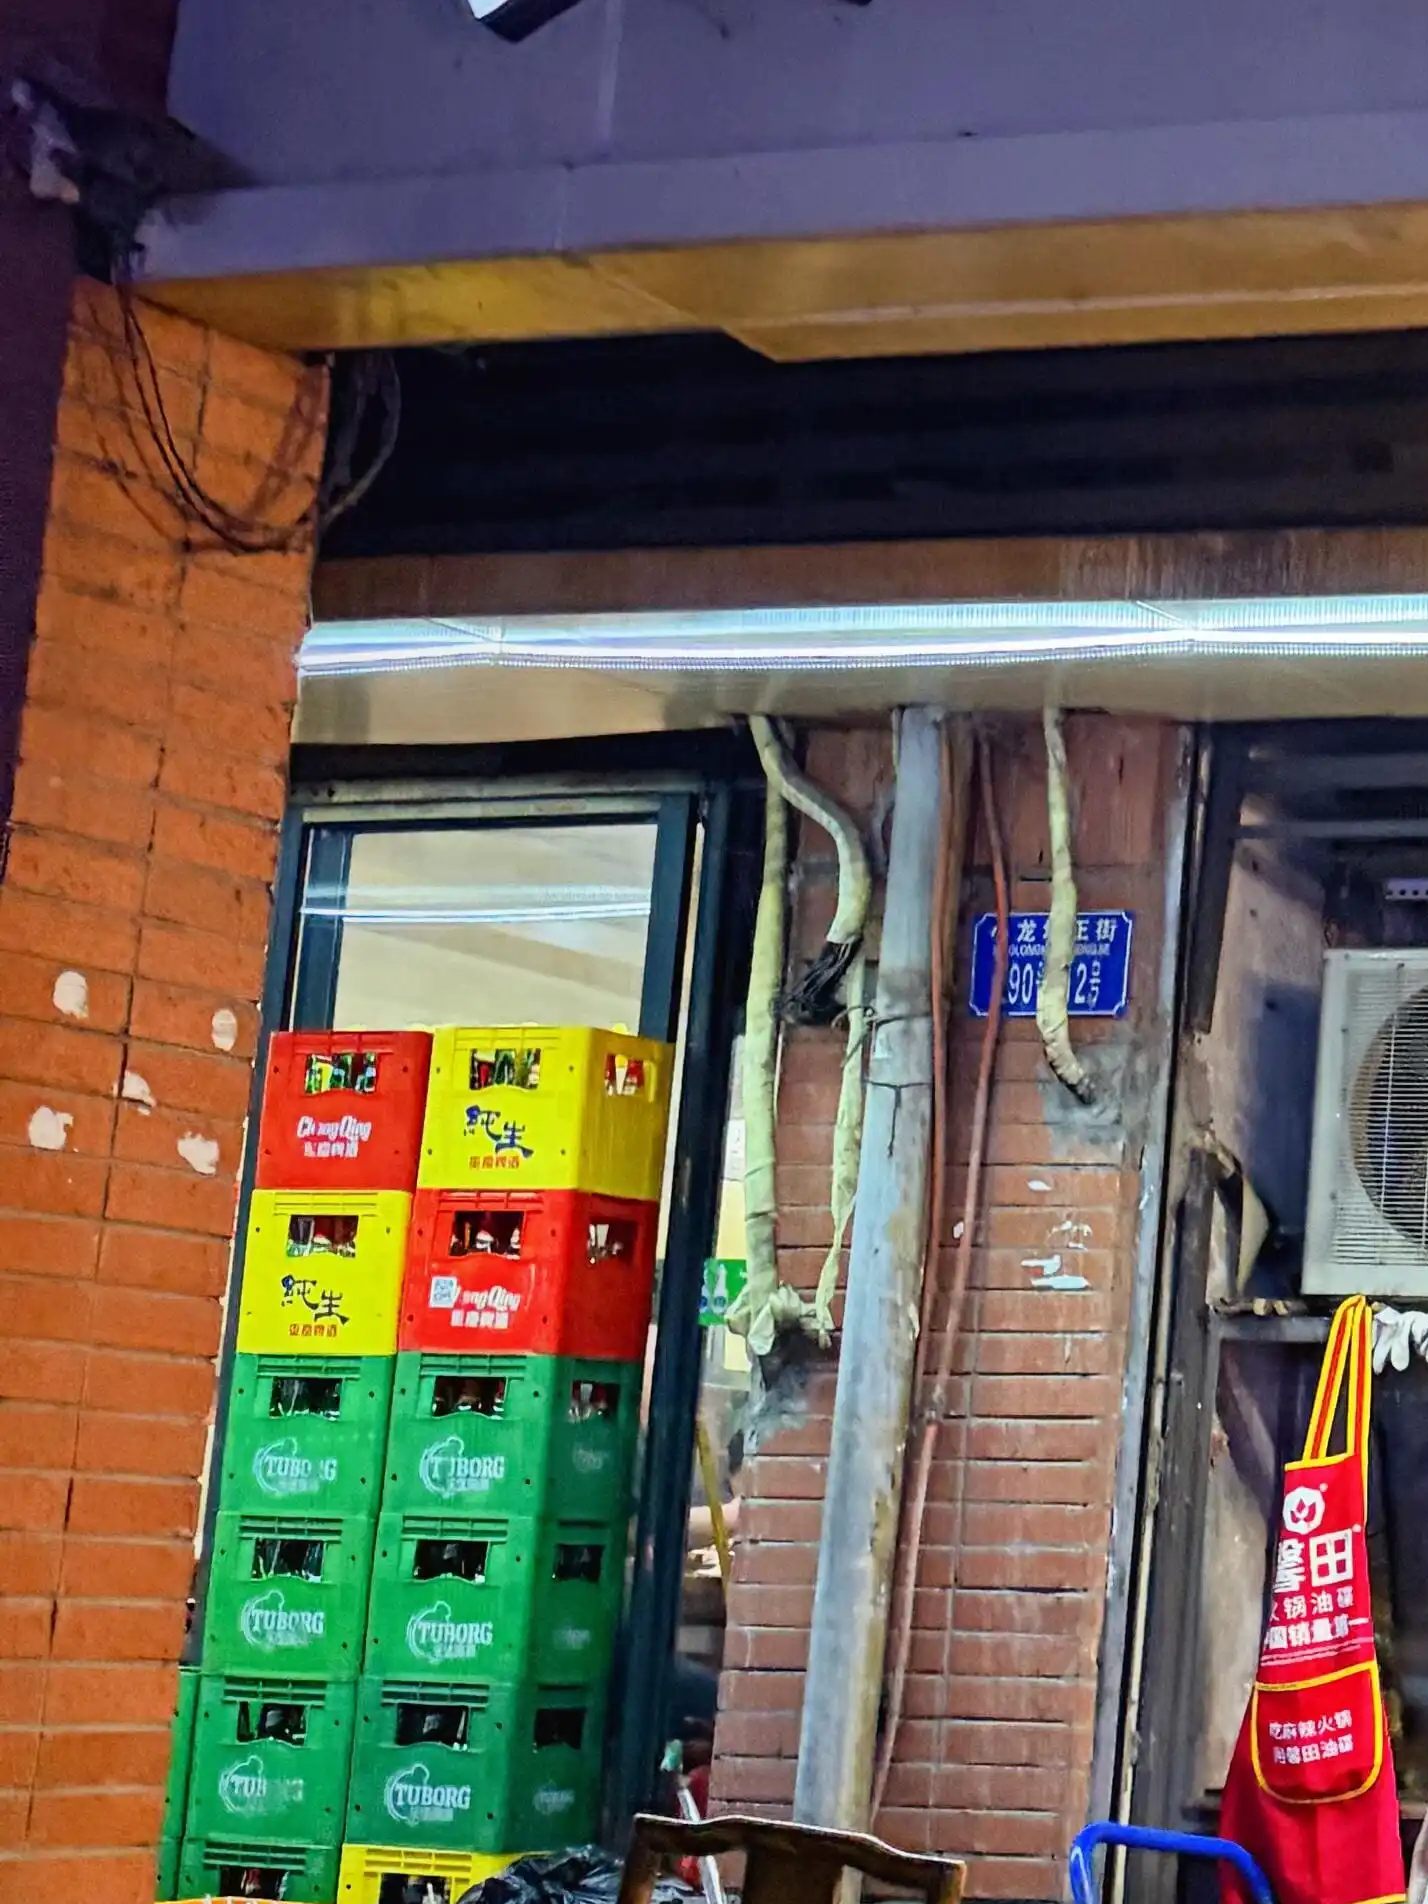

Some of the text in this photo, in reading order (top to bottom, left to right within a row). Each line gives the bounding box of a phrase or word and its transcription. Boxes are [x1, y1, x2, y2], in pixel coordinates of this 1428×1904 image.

[264, 1456, 338, 1482] TUBOG
[252, 1608, 325, 1635] TUBORG
[418, 1621, 494, 1647] TUBORG
[230, 1775, 304, 1802] TUBG
[394, 1783, 471, 1811] TUBORG
